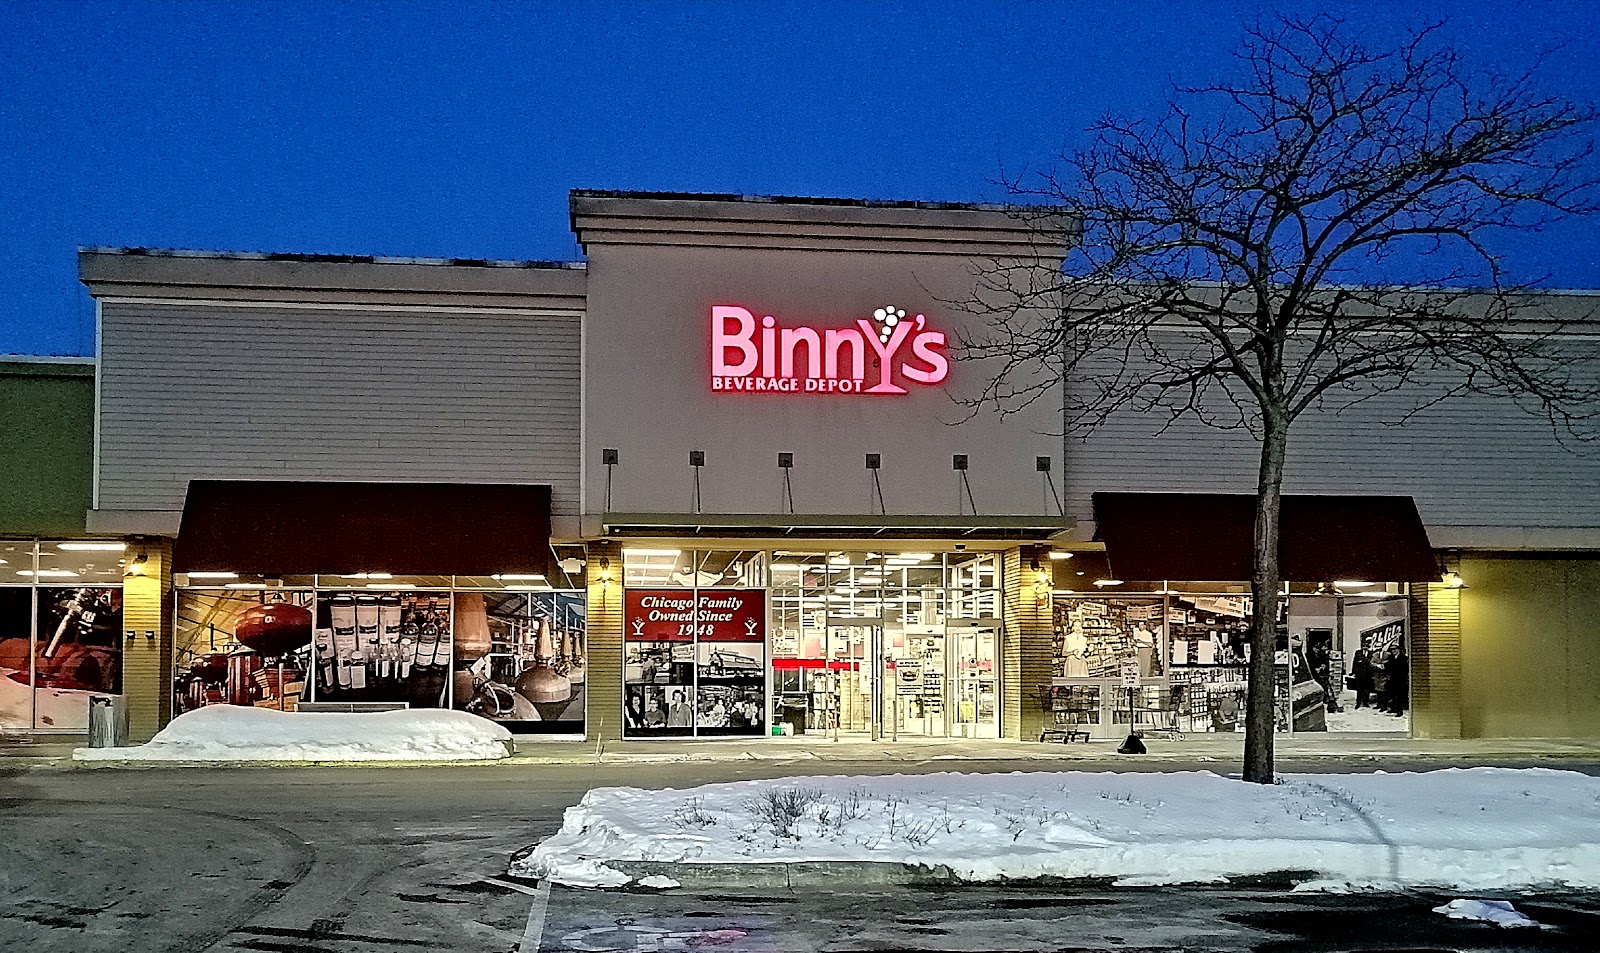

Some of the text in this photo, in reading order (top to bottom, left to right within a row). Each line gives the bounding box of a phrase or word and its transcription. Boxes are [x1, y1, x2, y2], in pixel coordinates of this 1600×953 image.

[712, 377, 863, 392] BEVERAGE DEPOT
[641, 596, 743, 610] Chicago Family
[648, 610, 733, 621] Owned Since
[677, 624, 715, 636] 1948
